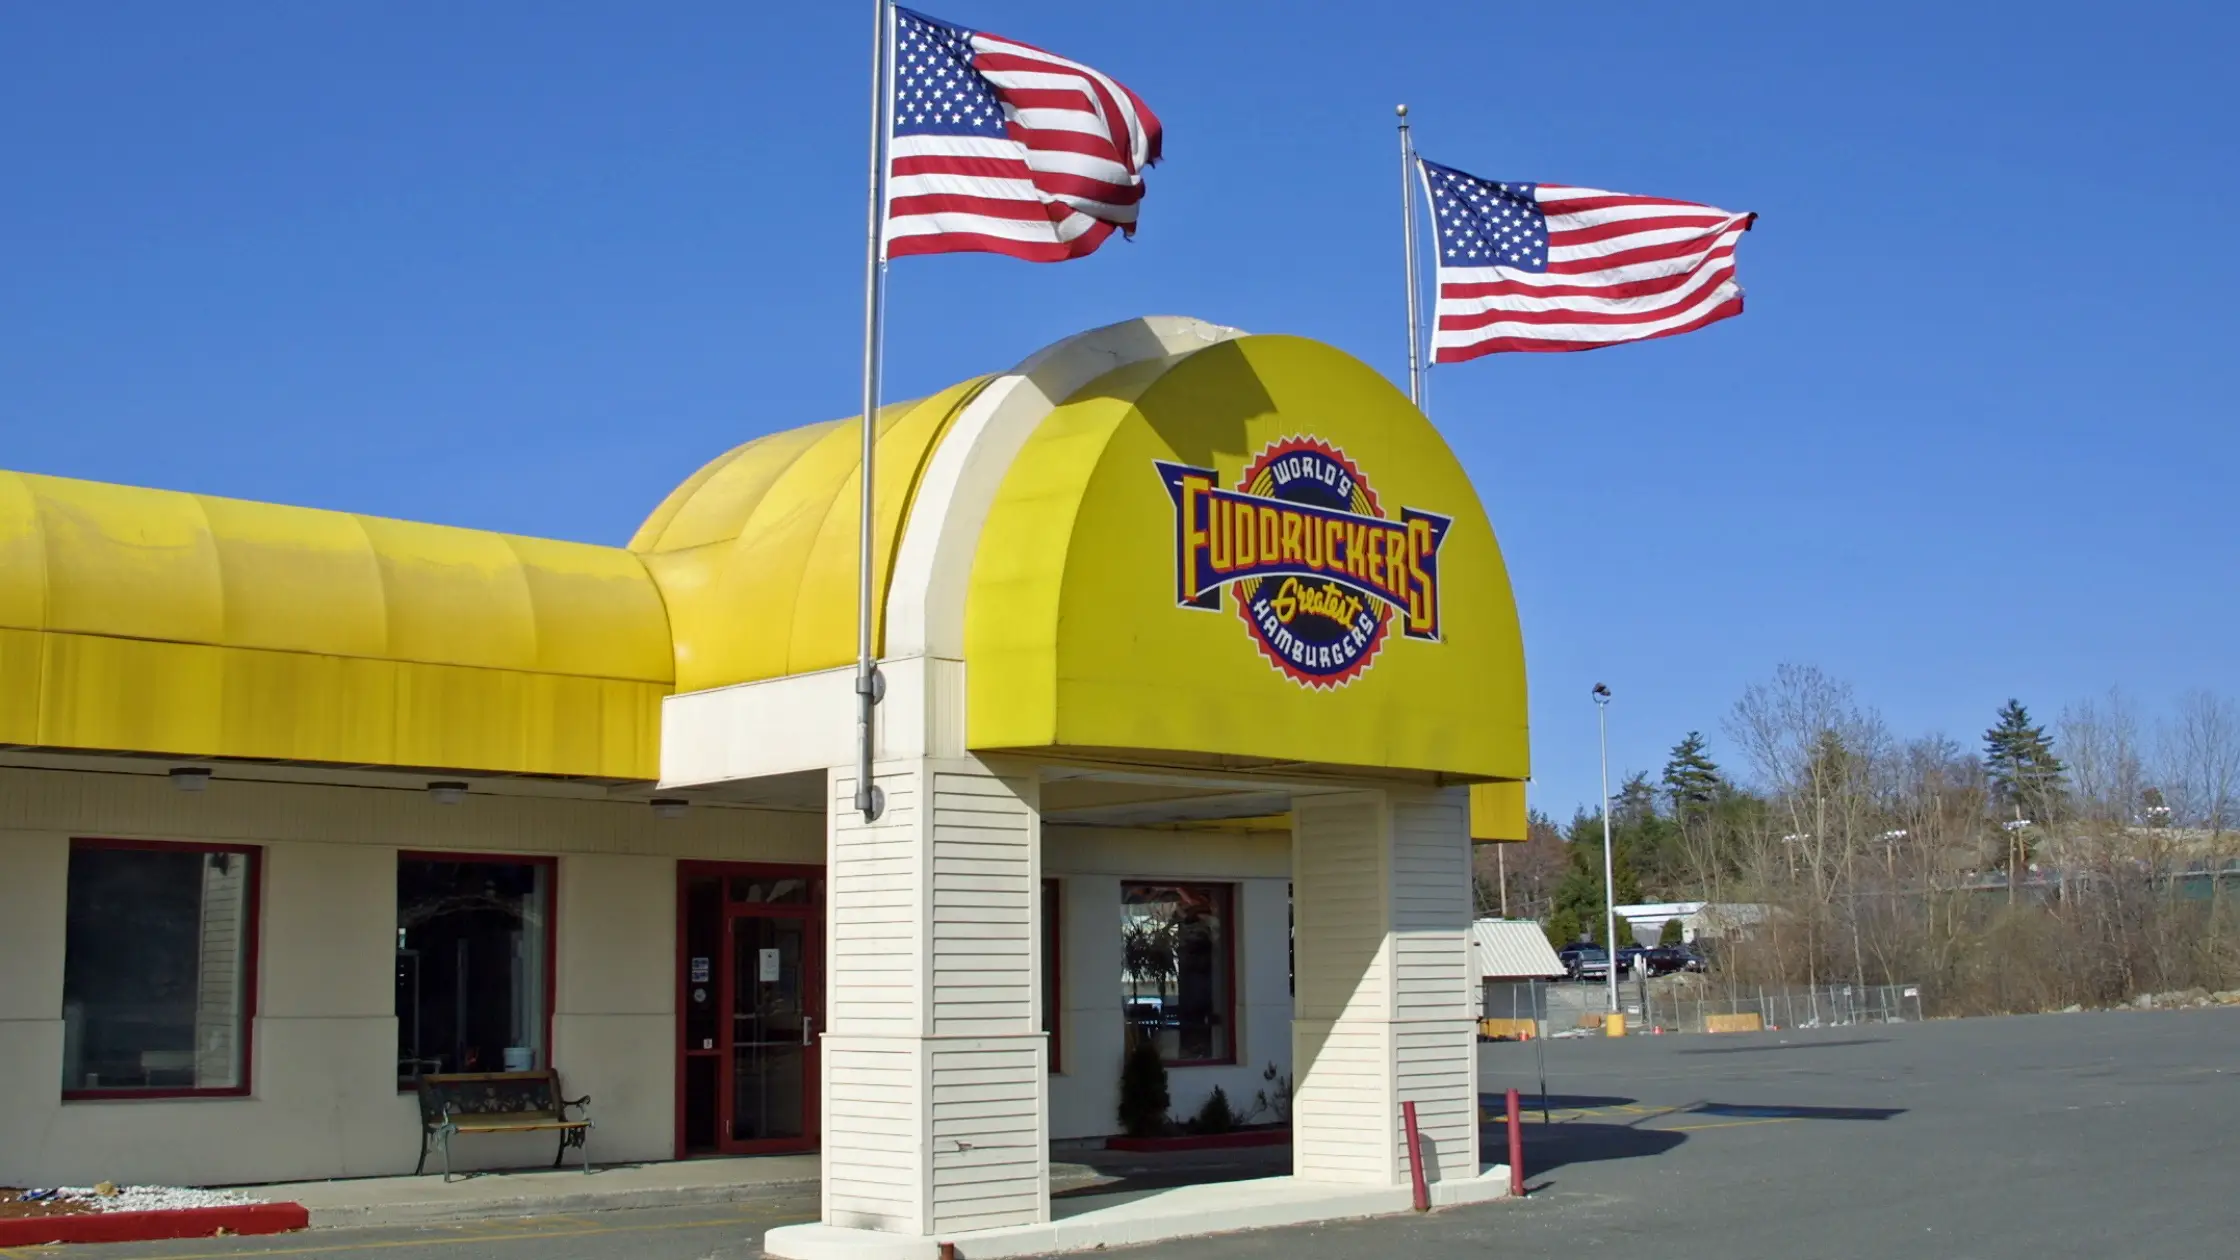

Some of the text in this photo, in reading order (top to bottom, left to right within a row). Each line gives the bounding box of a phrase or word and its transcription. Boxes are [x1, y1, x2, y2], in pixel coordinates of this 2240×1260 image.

[1273, 457, 1352, 498] WORLD'S
[1181, 474, 1434, 633] FUDDRUCKERS
[1253, 599, 1374, 668] HAMBURGERS
[1270, 577, 1364, 630] Greatest
